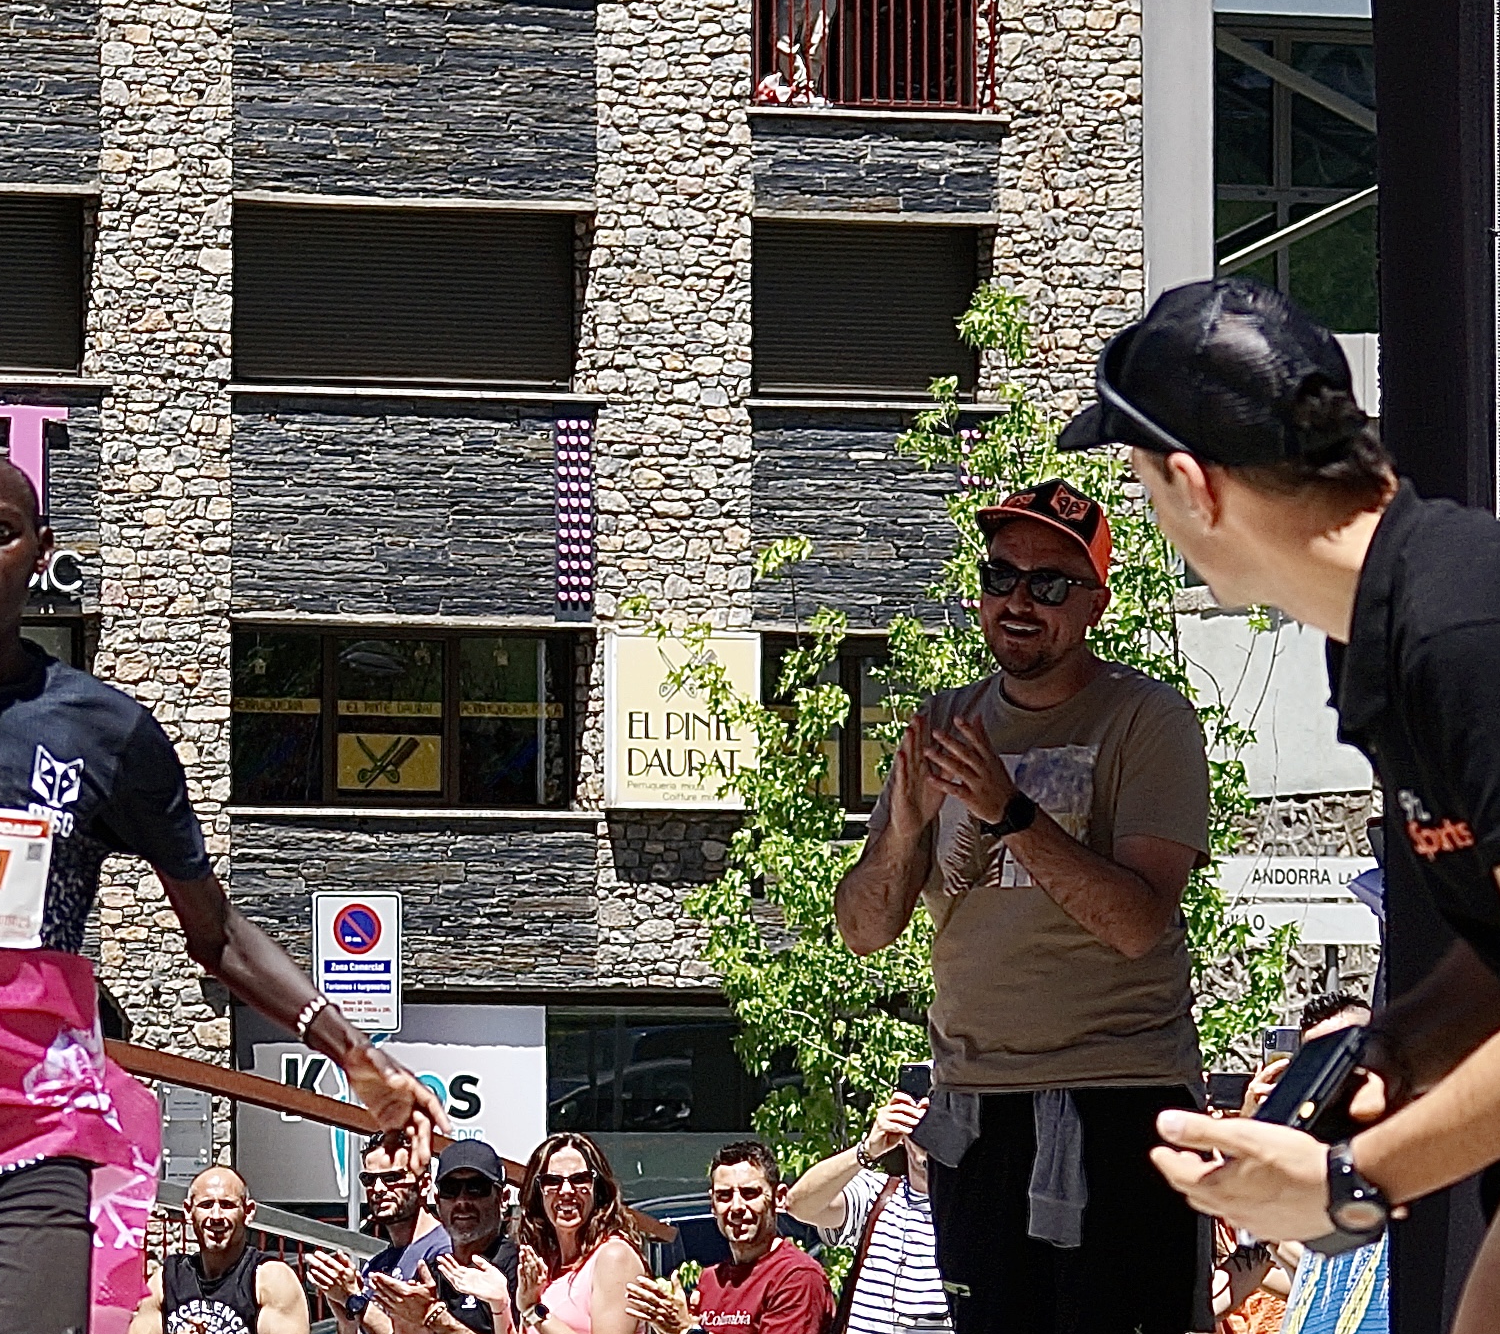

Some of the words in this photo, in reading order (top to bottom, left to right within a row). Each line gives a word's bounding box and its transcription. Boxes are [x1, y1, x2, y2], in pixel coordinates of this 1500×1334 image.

[628, 711, 659, 741] EL
[627, 748, 742, 778] DAURAT
[1251, 868, 1331, 886] ANDORRA
[706, 1310, 751, 1326] Columbia
